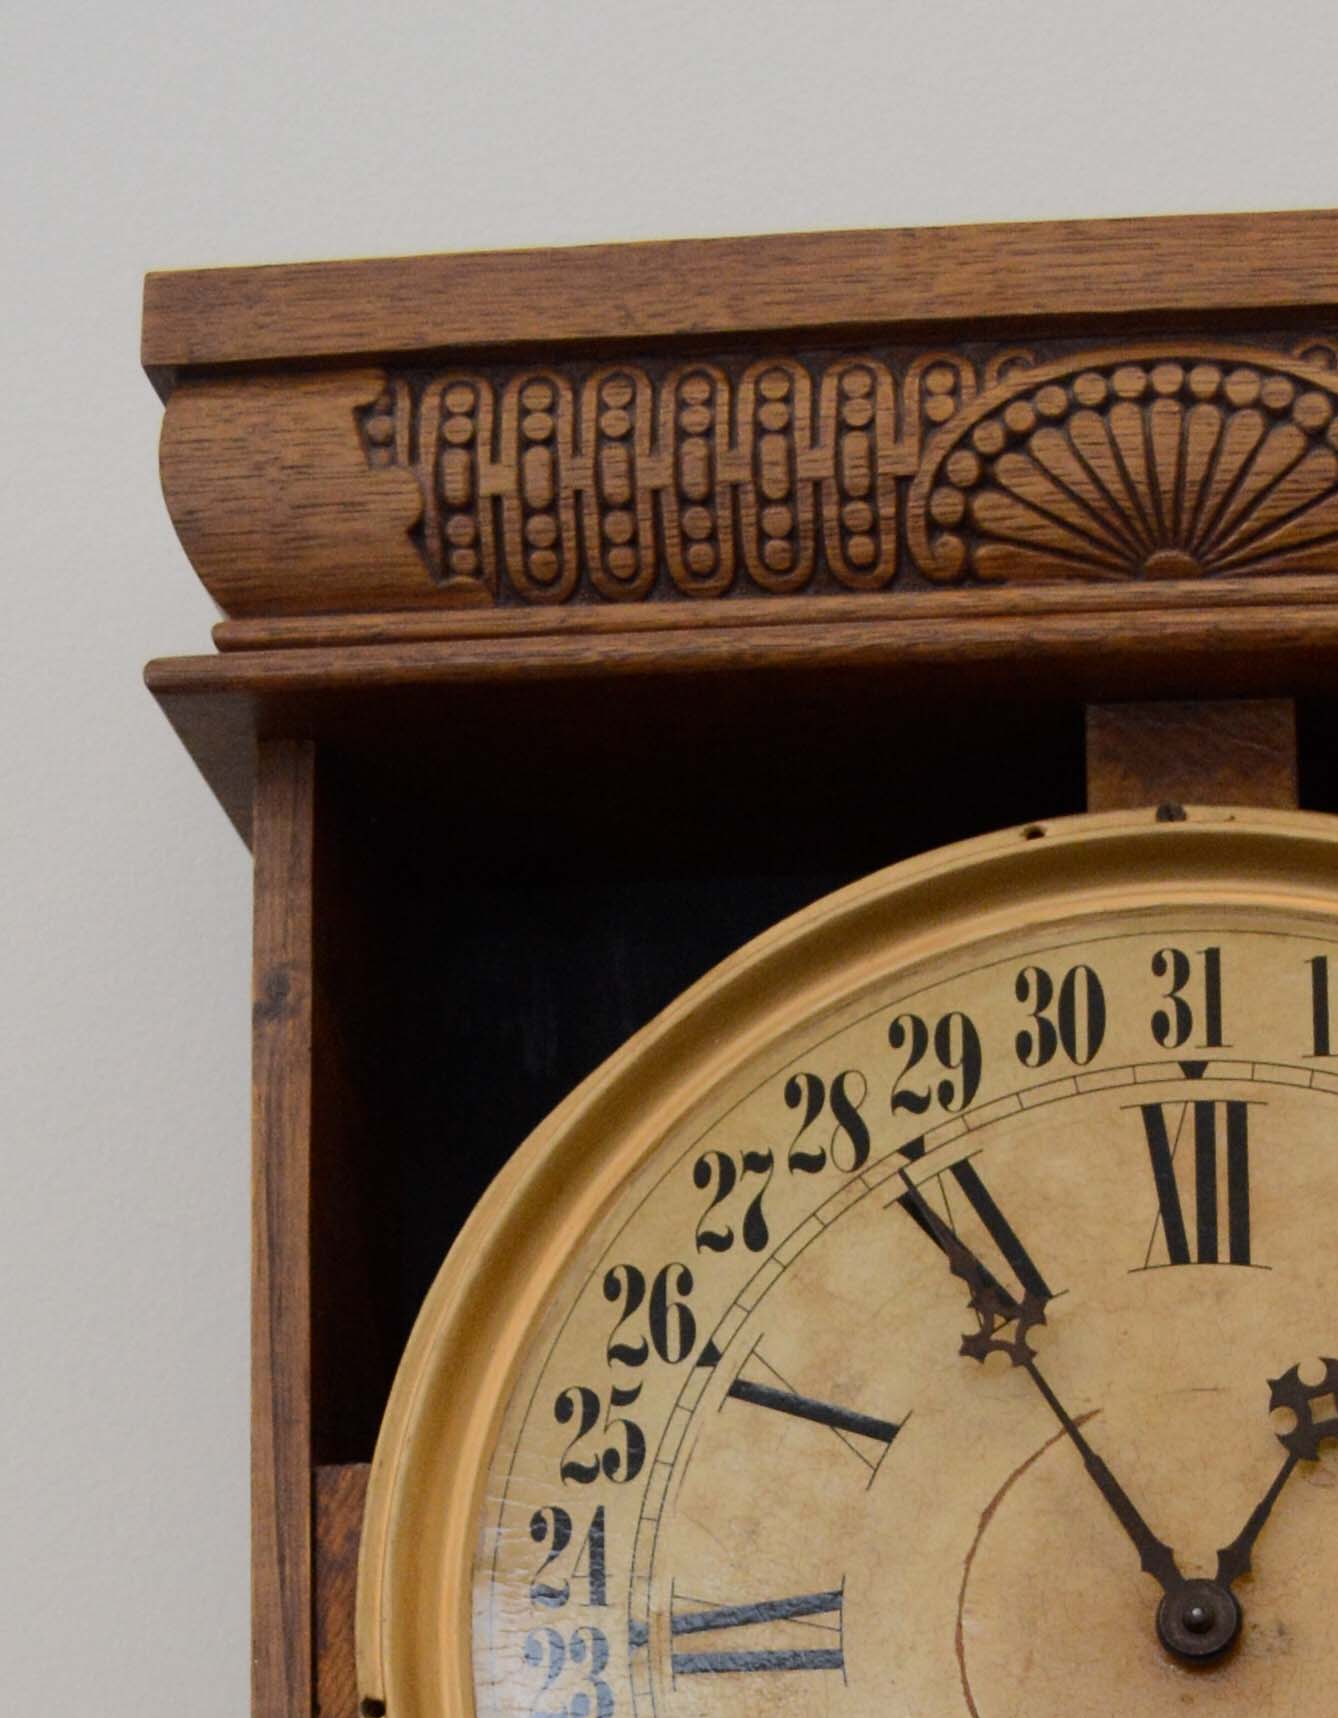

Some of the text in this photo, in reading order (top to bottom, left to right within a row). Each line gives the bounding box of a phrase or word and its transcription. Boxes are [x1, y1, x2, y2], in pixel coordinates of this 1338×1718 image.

[1014, 964, 1106, 1068] 30
[1150, 947, 1233, 1049] 31
[887, 1011, 983, 1114] 29
[784, 1069, 871, 1174] 28
[693, 1147, 774, 1253] 27
[602, 1261, 697, 1368] 26
[554, 1381, 646, 1486] 25
[529, 1504, 610, 1608] 24
